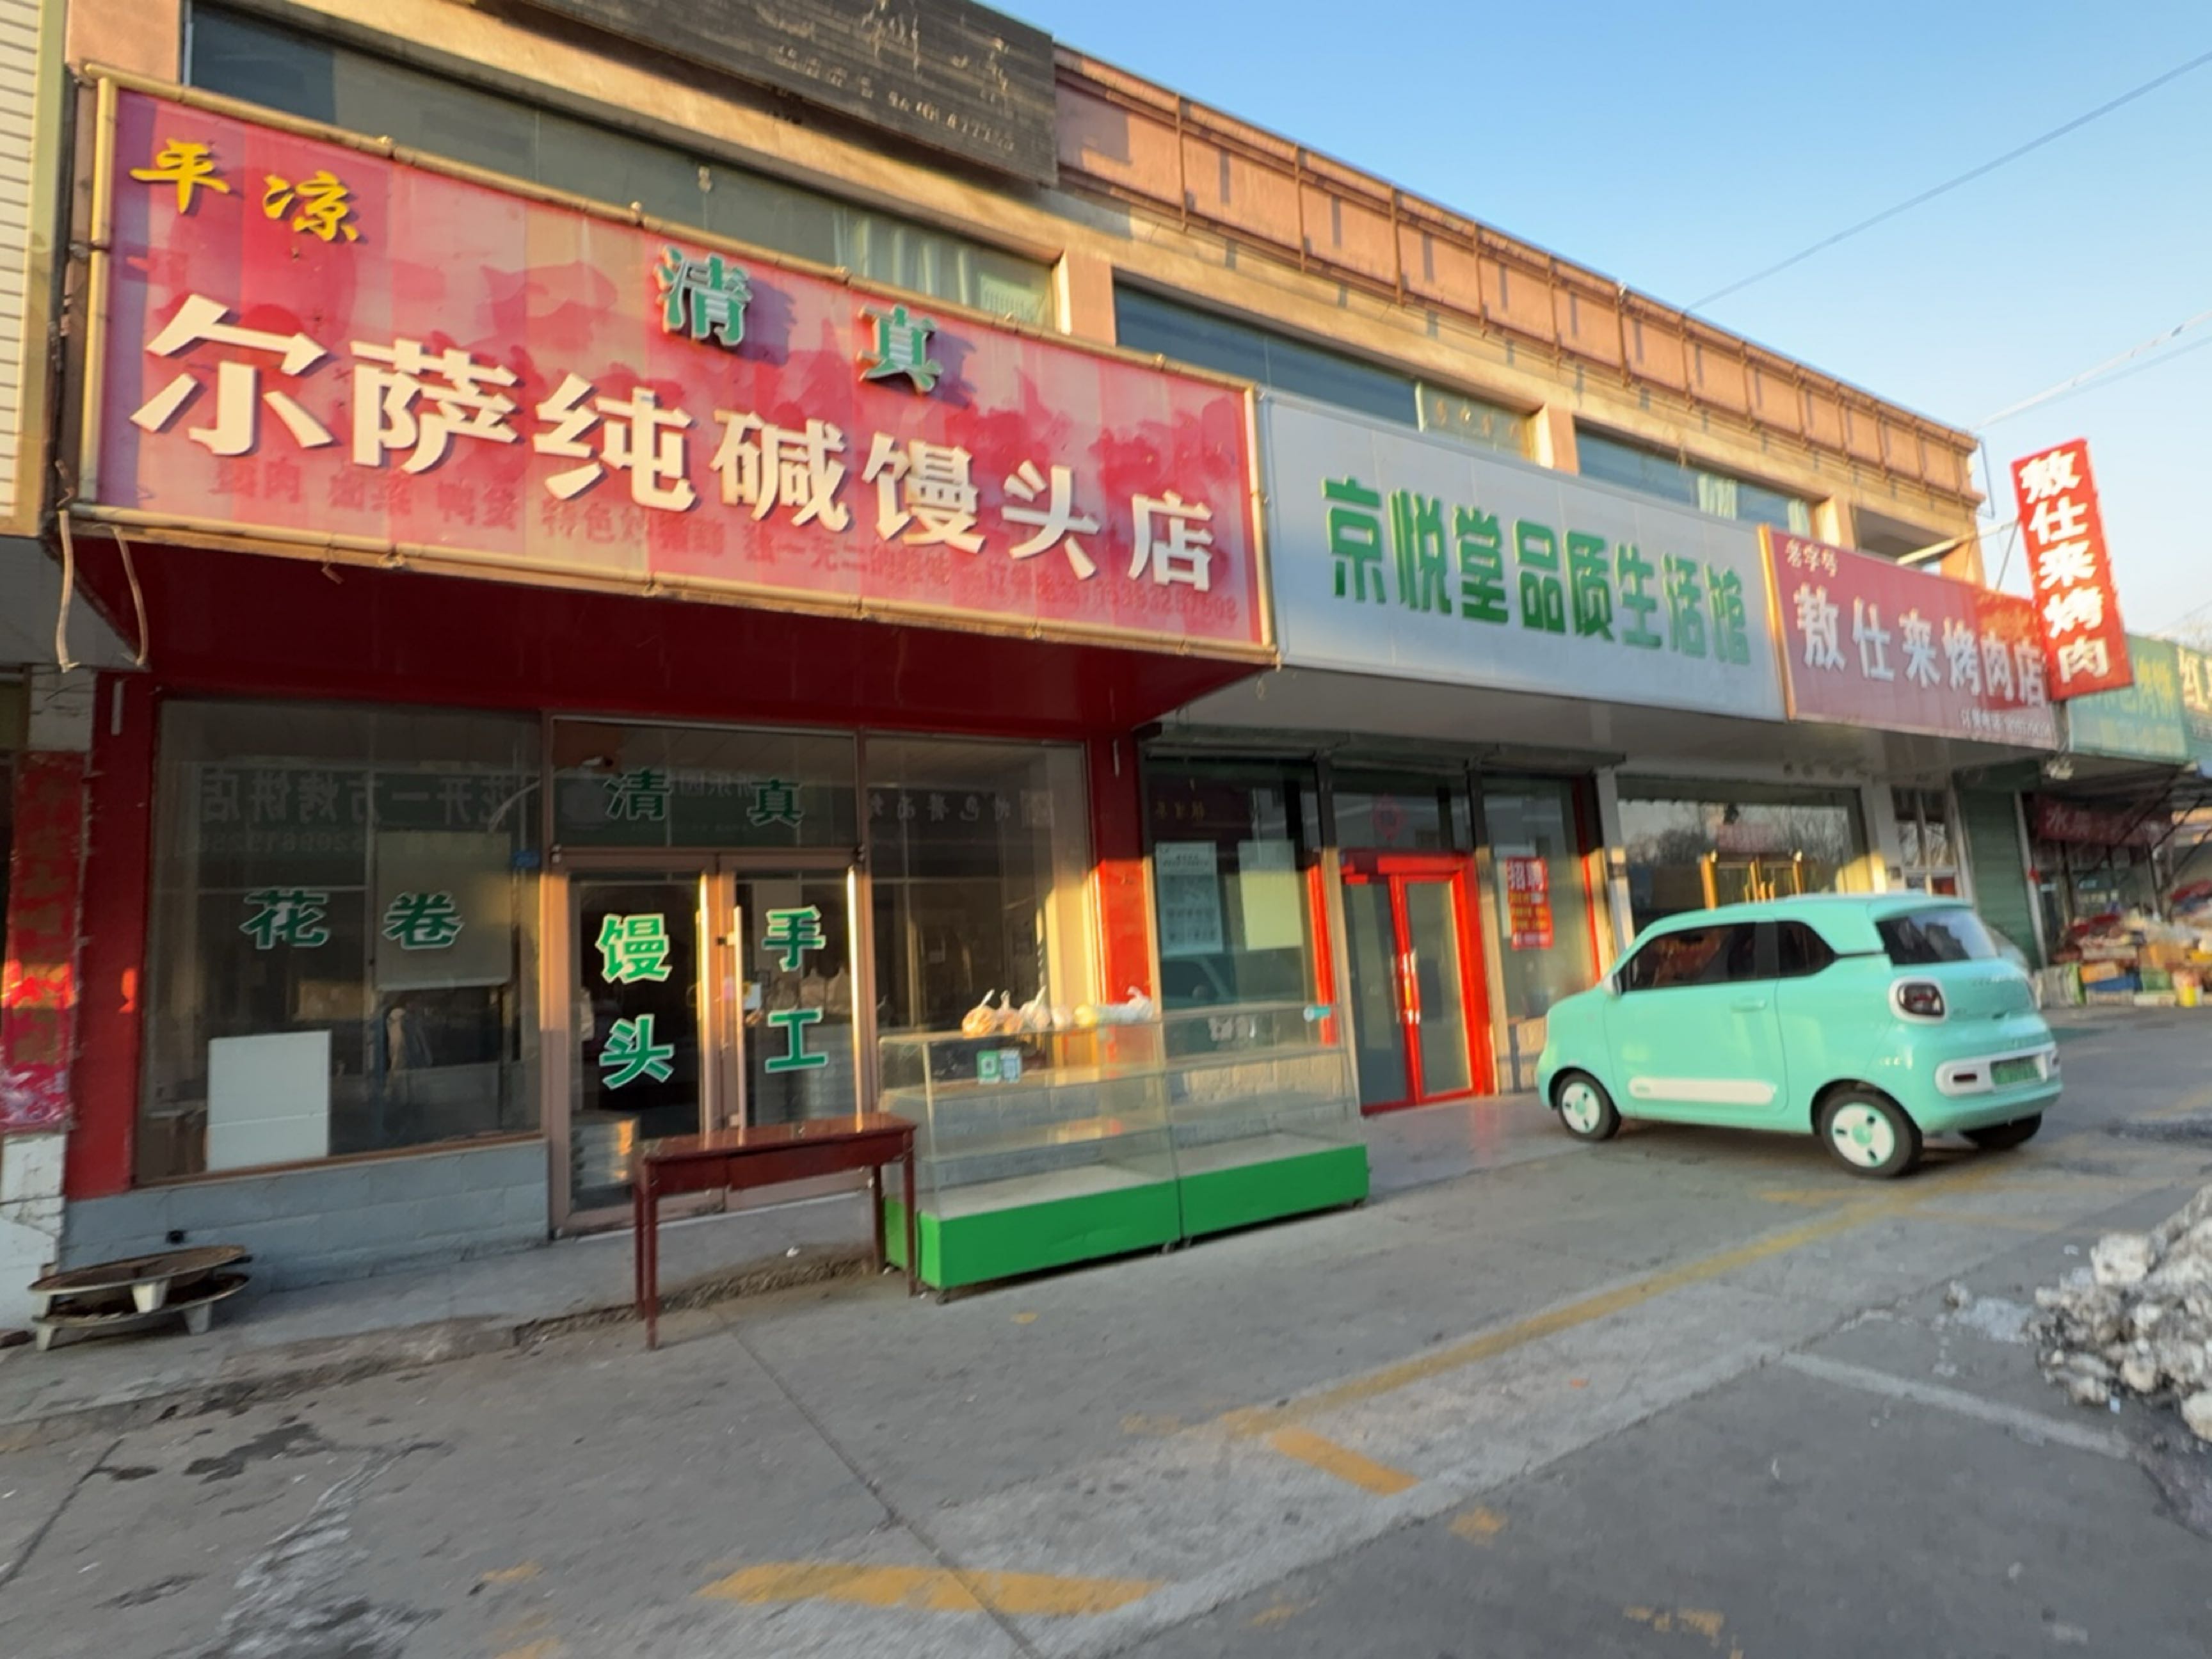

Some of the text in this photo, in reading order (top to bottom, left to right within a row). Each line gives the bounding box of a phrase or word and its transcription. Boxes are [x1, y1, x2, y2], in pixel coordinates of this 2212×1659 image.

[130, 139, 360, 242] 平凉
[653, 244, 943, 394] 清真
[130, 294, 1214, 592] 尔萨纯碱馒头店
[1321, 475, 1751, 666] 京悦堂品质生活馆
[1793, 582, 2047, 708] 敖仕来烤肉店
[602, 767, 805, 828] 清真
[239, 887, 463, 950] 花卷
[762, 904, 830, 1073] 手工
[596, 913, 675, 1091] 馒头
